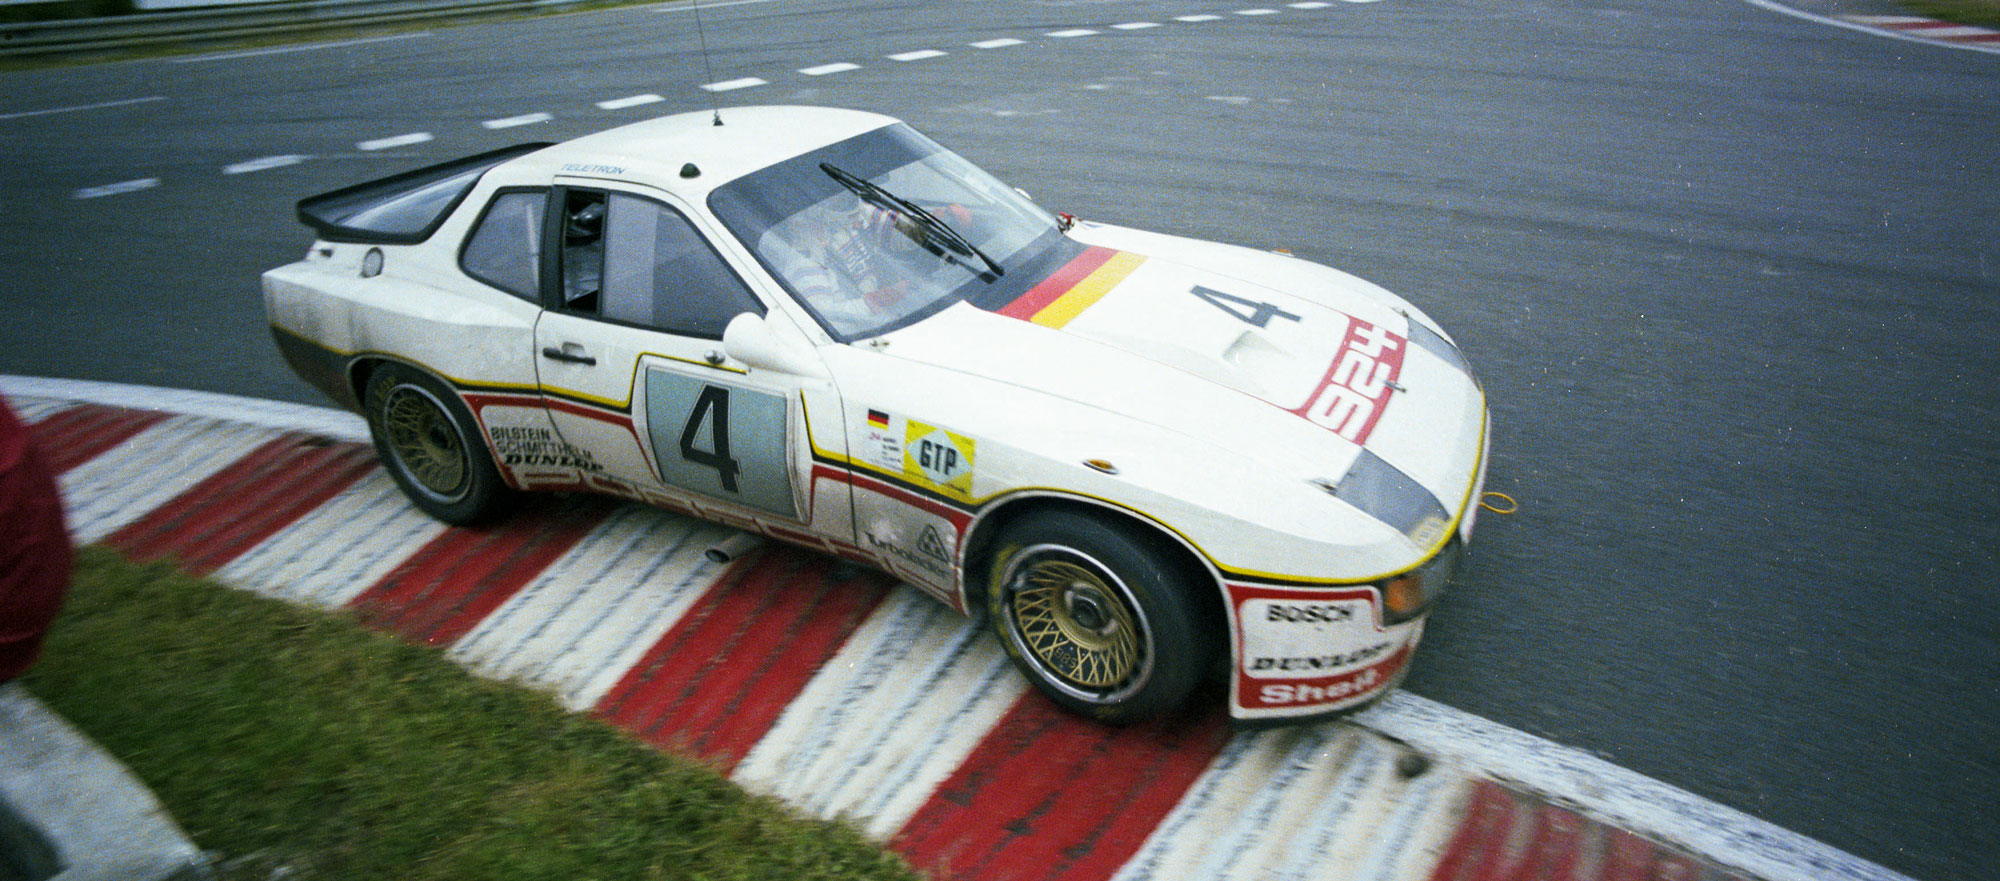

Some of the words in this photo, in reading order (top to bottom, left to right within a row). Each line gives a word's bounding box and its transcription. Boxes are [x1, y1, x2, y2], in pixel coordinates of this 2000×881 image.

[560, 163, 626, 175] TELETRON
[1190, 285, 1302, 329] 4
[1306, 321, 1401, 446] 924
[489, 426, 551, 440] BILSTEIN
[679, 383, 742, 494] 4
[504, 454, 604, 471] DUNLOP
[919, 438, 957, 476] GTP
[1267, 604, 1354, 623] BOSCH
[1259, 667, 1378, 704] Shell
